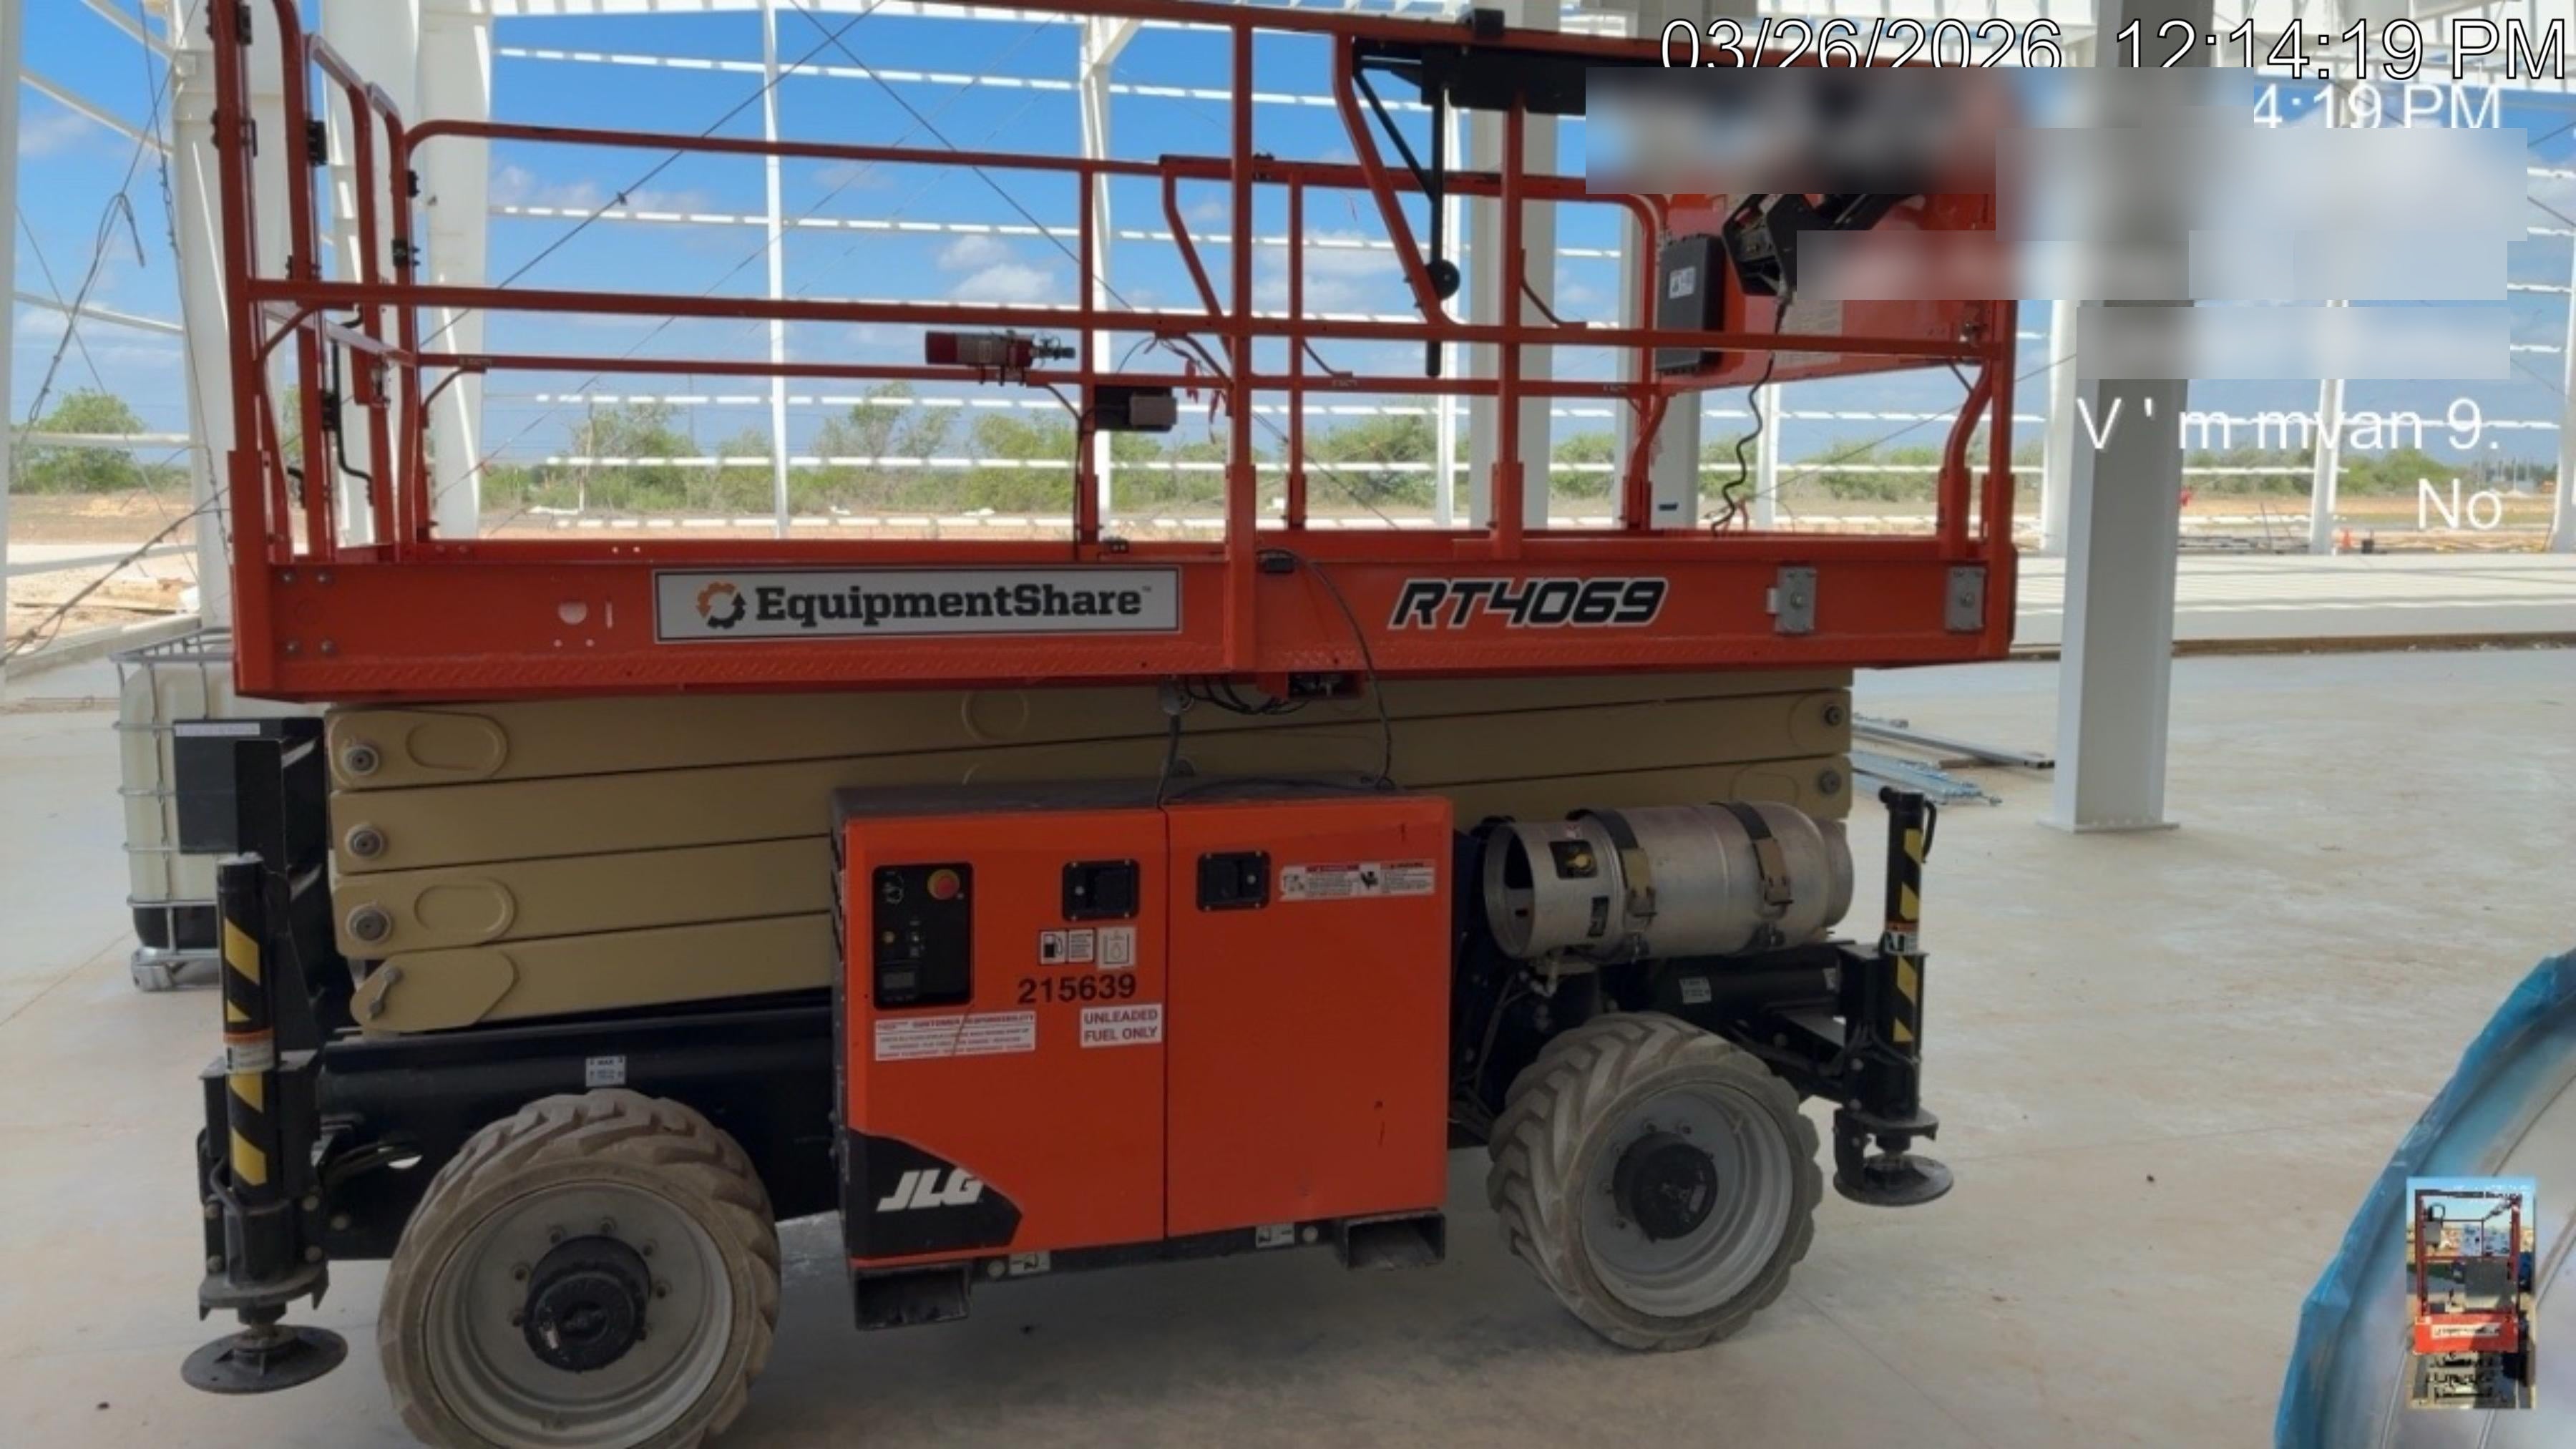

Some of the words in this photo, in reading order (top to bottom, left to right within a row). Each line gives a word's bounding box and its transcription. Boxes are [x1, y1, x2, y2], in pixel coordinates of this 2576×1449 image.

[1387, 577, 1668, 629] RT4069
[1018, 973, 1136, 1005] 215639
[1084, 1008, 1158, 1025] UNLEADED
[1084, 1028, 1117, 1042] FUEL
[1122, 1026, 1158, 1039] ONLY
[876, 1167, 984, 1211] JLG
